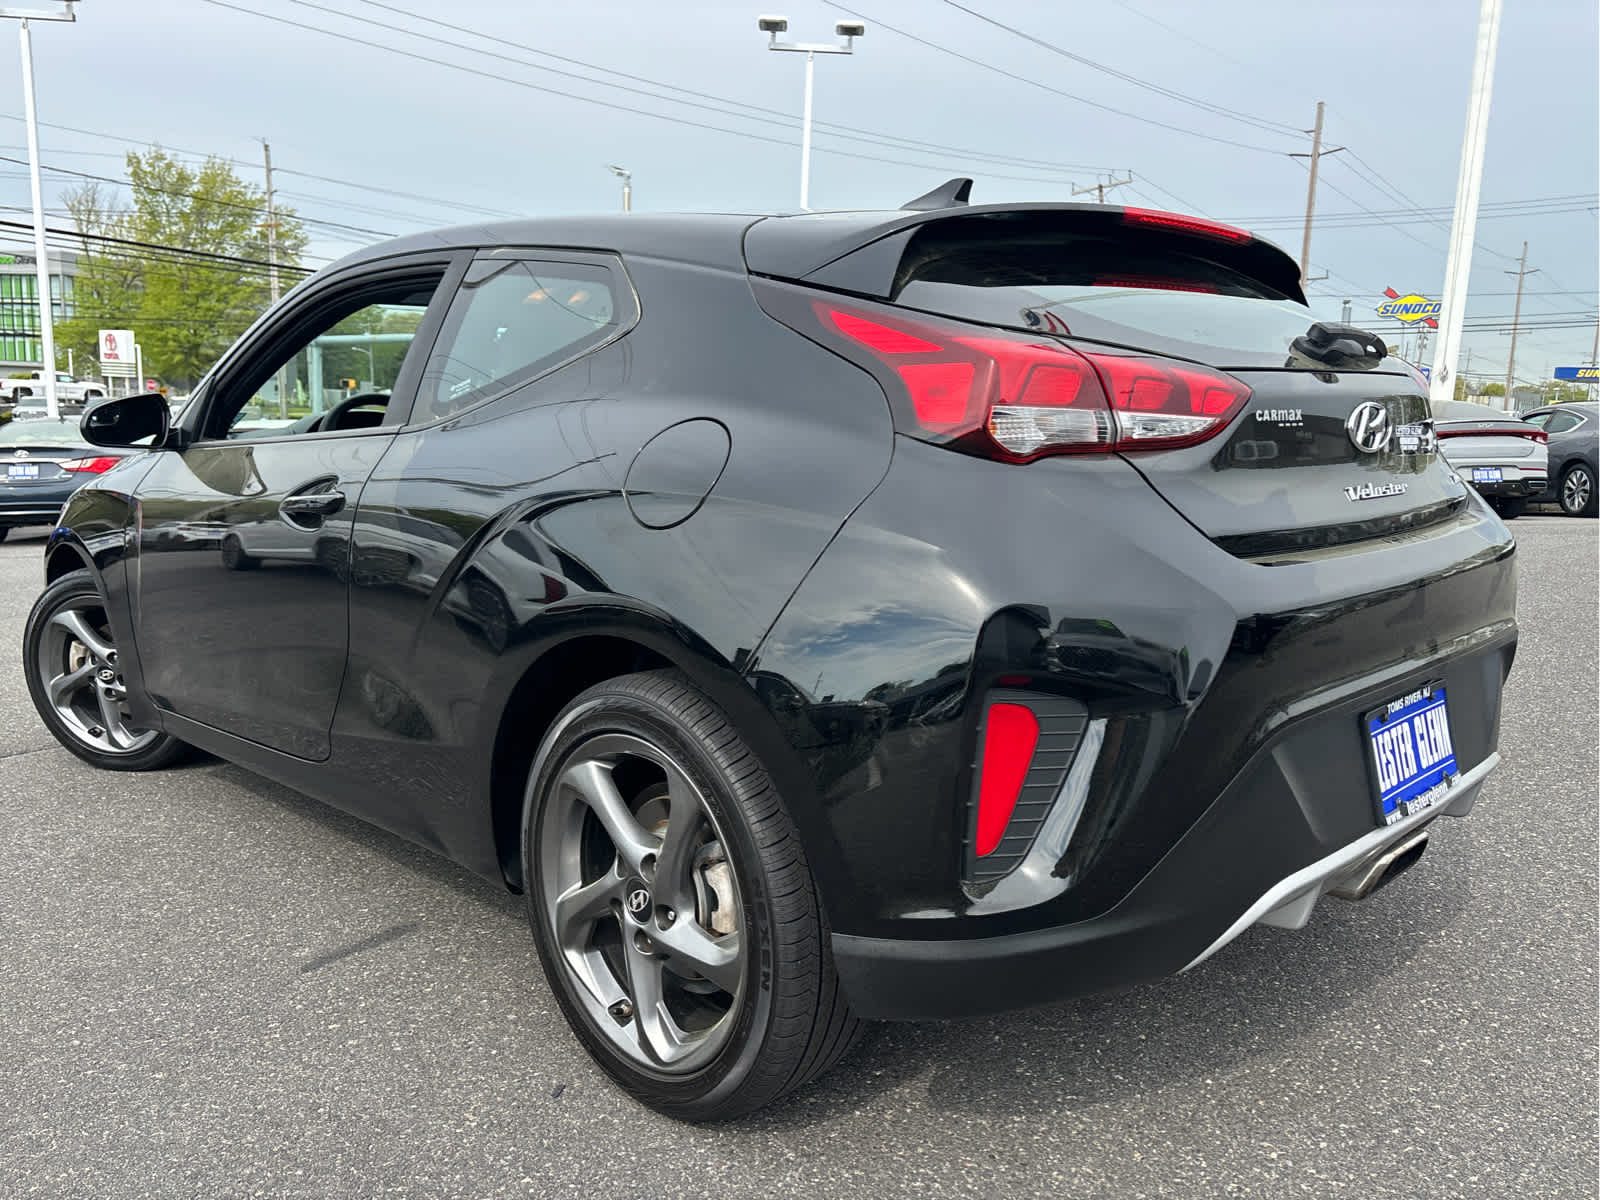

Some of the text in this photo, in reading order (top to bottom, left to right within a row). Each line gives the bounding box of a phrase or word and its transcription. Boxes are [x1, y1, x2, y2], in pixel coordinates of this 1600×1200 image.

[1380, 302, 1442, 315] SUNOCO
[1344, 482, 1409, 502] Veloster
[1387, 697, 1404, 715] TOMS
[1423, 686, 1432, 700] NJ
[1371, 703, 1454, 794] LESTER GLENN
